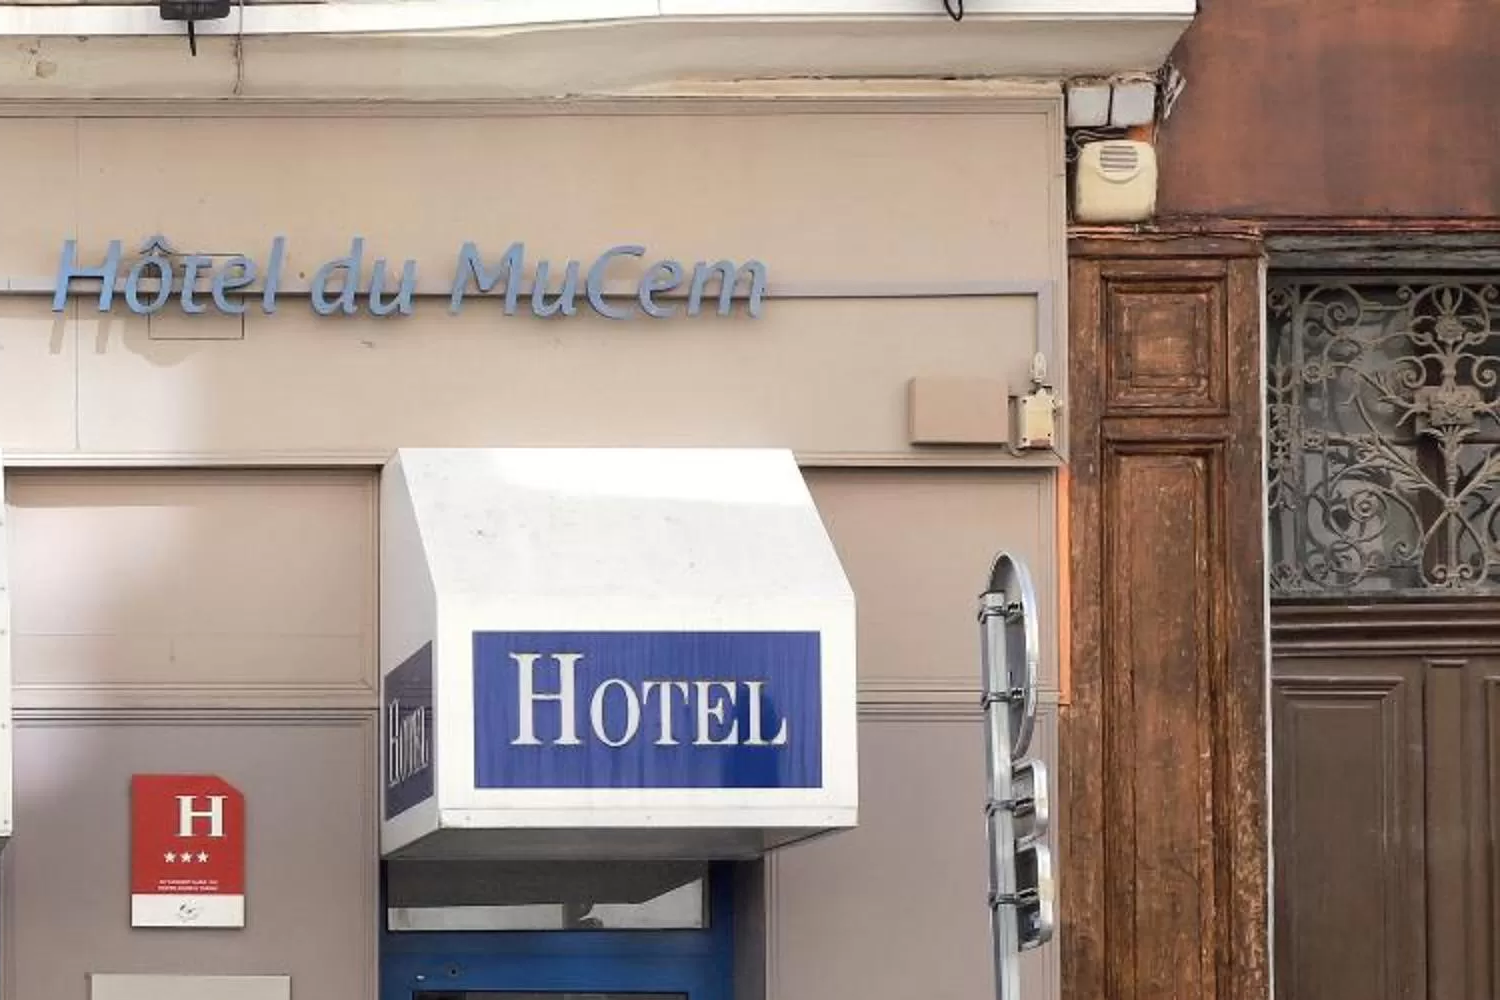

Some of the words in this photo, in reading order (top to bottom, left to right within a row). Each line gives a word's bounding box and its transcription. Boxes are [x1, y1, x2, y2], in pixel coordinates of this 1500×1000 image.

[51, 235, 287, 317] Hôtel
[309, 237, 417, 317] du
[447, 240, 767, 320] MuCem
[174, 795, 228, 837] H
